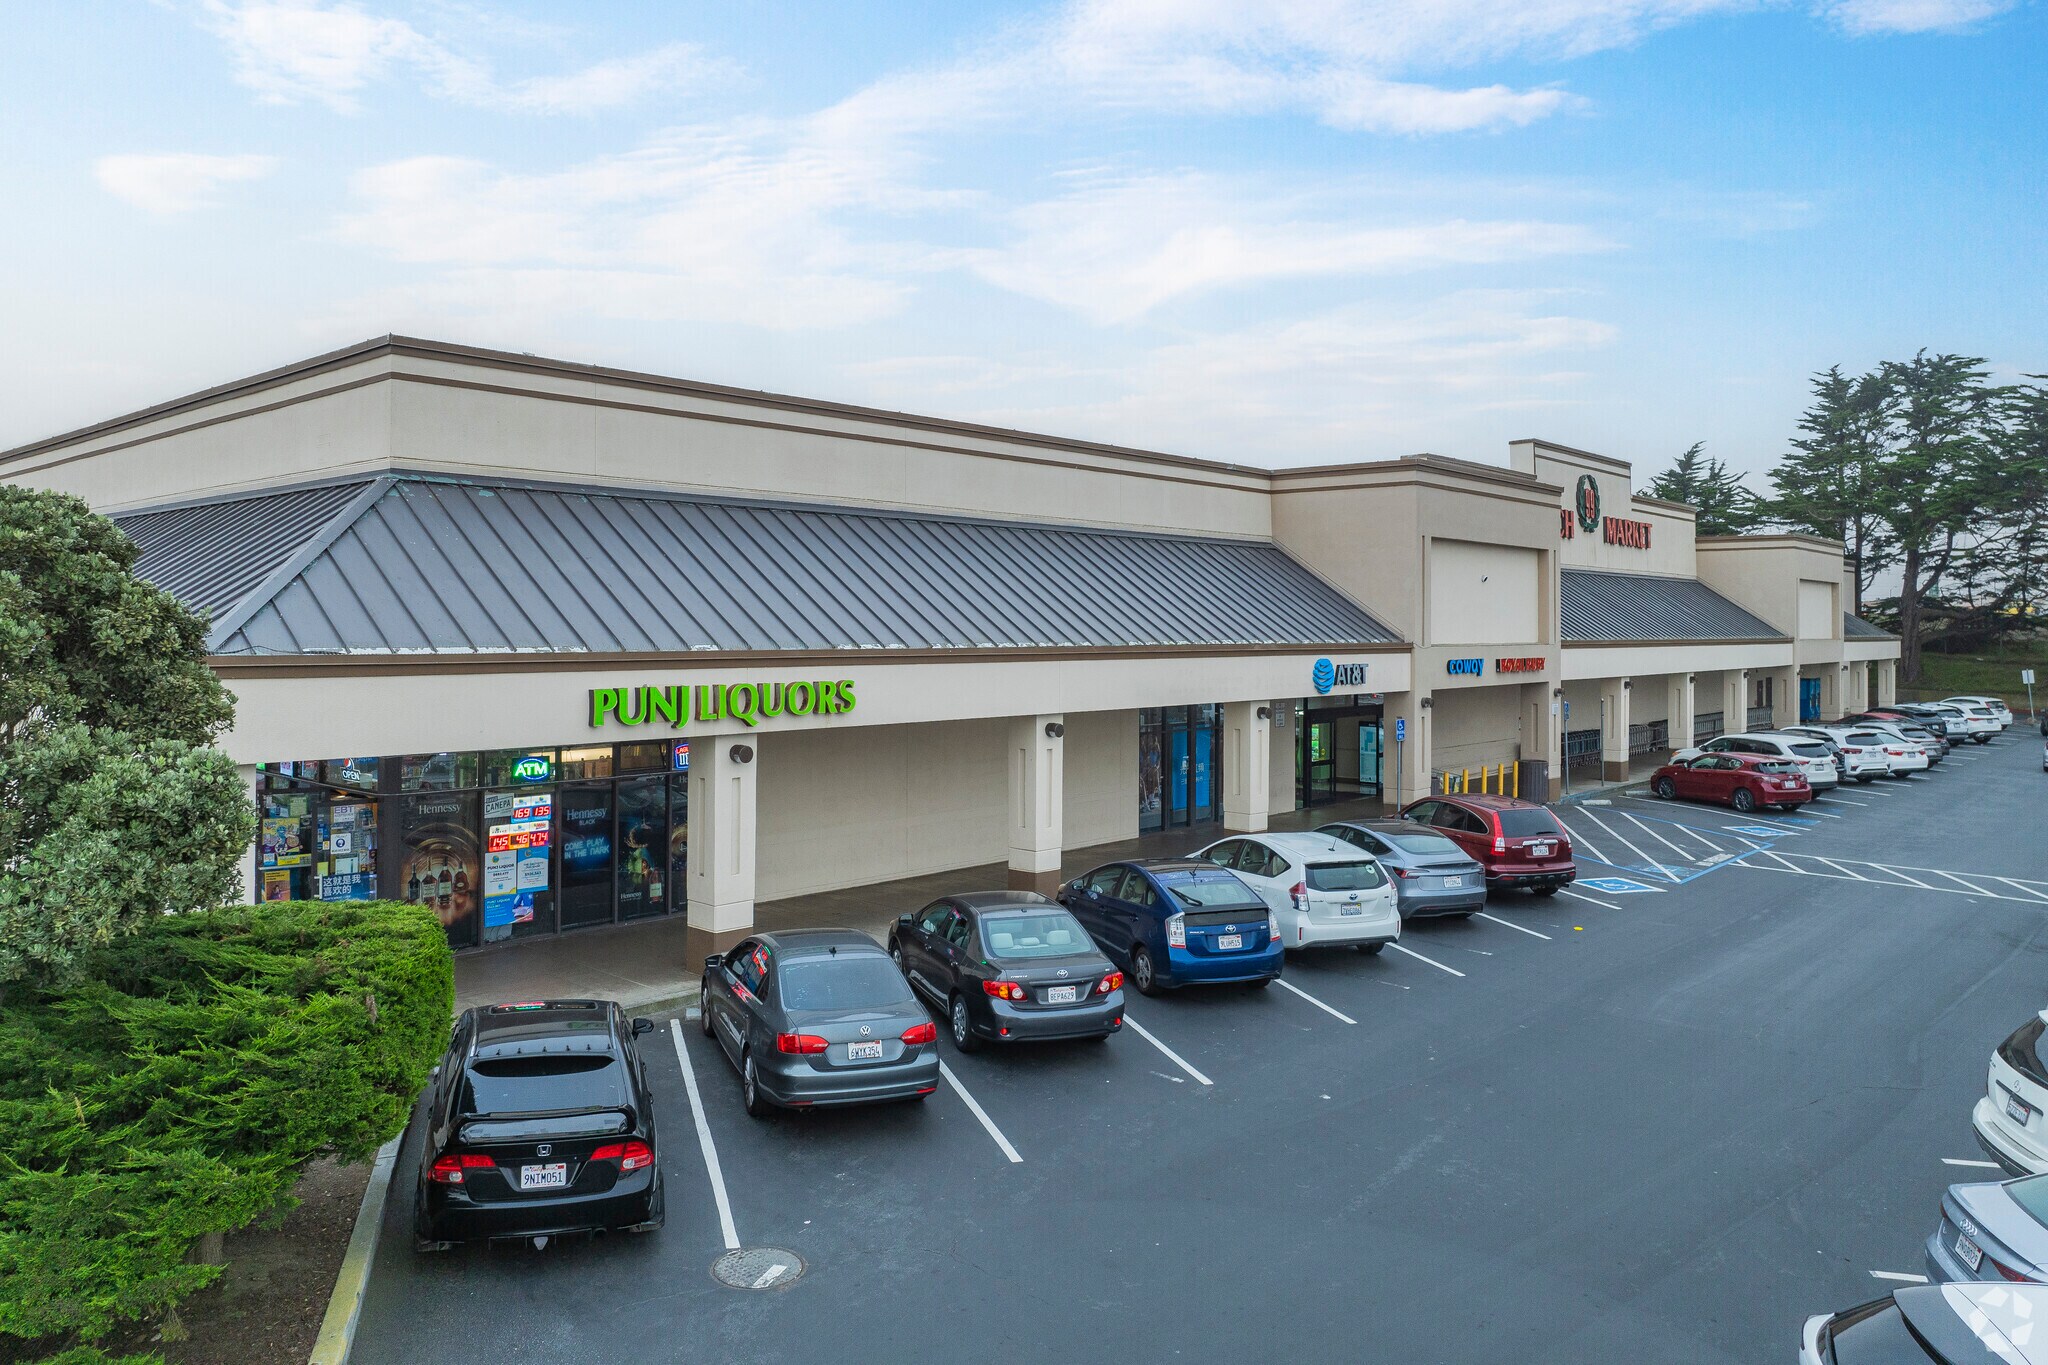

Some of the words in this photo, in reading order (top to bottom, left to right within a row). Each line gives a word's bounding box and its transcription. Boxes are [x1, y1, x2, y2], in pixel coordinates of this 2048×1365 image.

[1585, 488, 1595, 519] 99
[1604, 516, 1652, 549] MARKET
[1500, 658, 1525, 673] ROYAL
[1335, 663, 1369, 686] AT&T
[589, 685, 690, 729] PUNJ
[697, 680, 857, 727] LIQUORS
[342, 770, 360, 780] OPEN
[514, 762, 548, 777] ATM
[334, 805, 353, 814] EBT
[418, 803, 462, 815] Hennessy
[485, 800, 511, 813] CANEPA
[514, 808, 530, 818] 169
[534, 806, 549, 816] 135
[567, 807, 607, 820] Hennessy
[493, 836, 508, 847] 145
[516, 834, 528, 844] 46
[530, 832, 547, 842] 474
[564, 840, 584, 851] COME
[586, 836, 605, 847] PLAY
[564, 851, 572, 860] IN
[574, 848, 587, 858] THE
[323, 873, 362, 887] 这就是我
[323, 884, 352, 897] 喜欢的
[523, 1172, 563, 1186] 9NIM051
